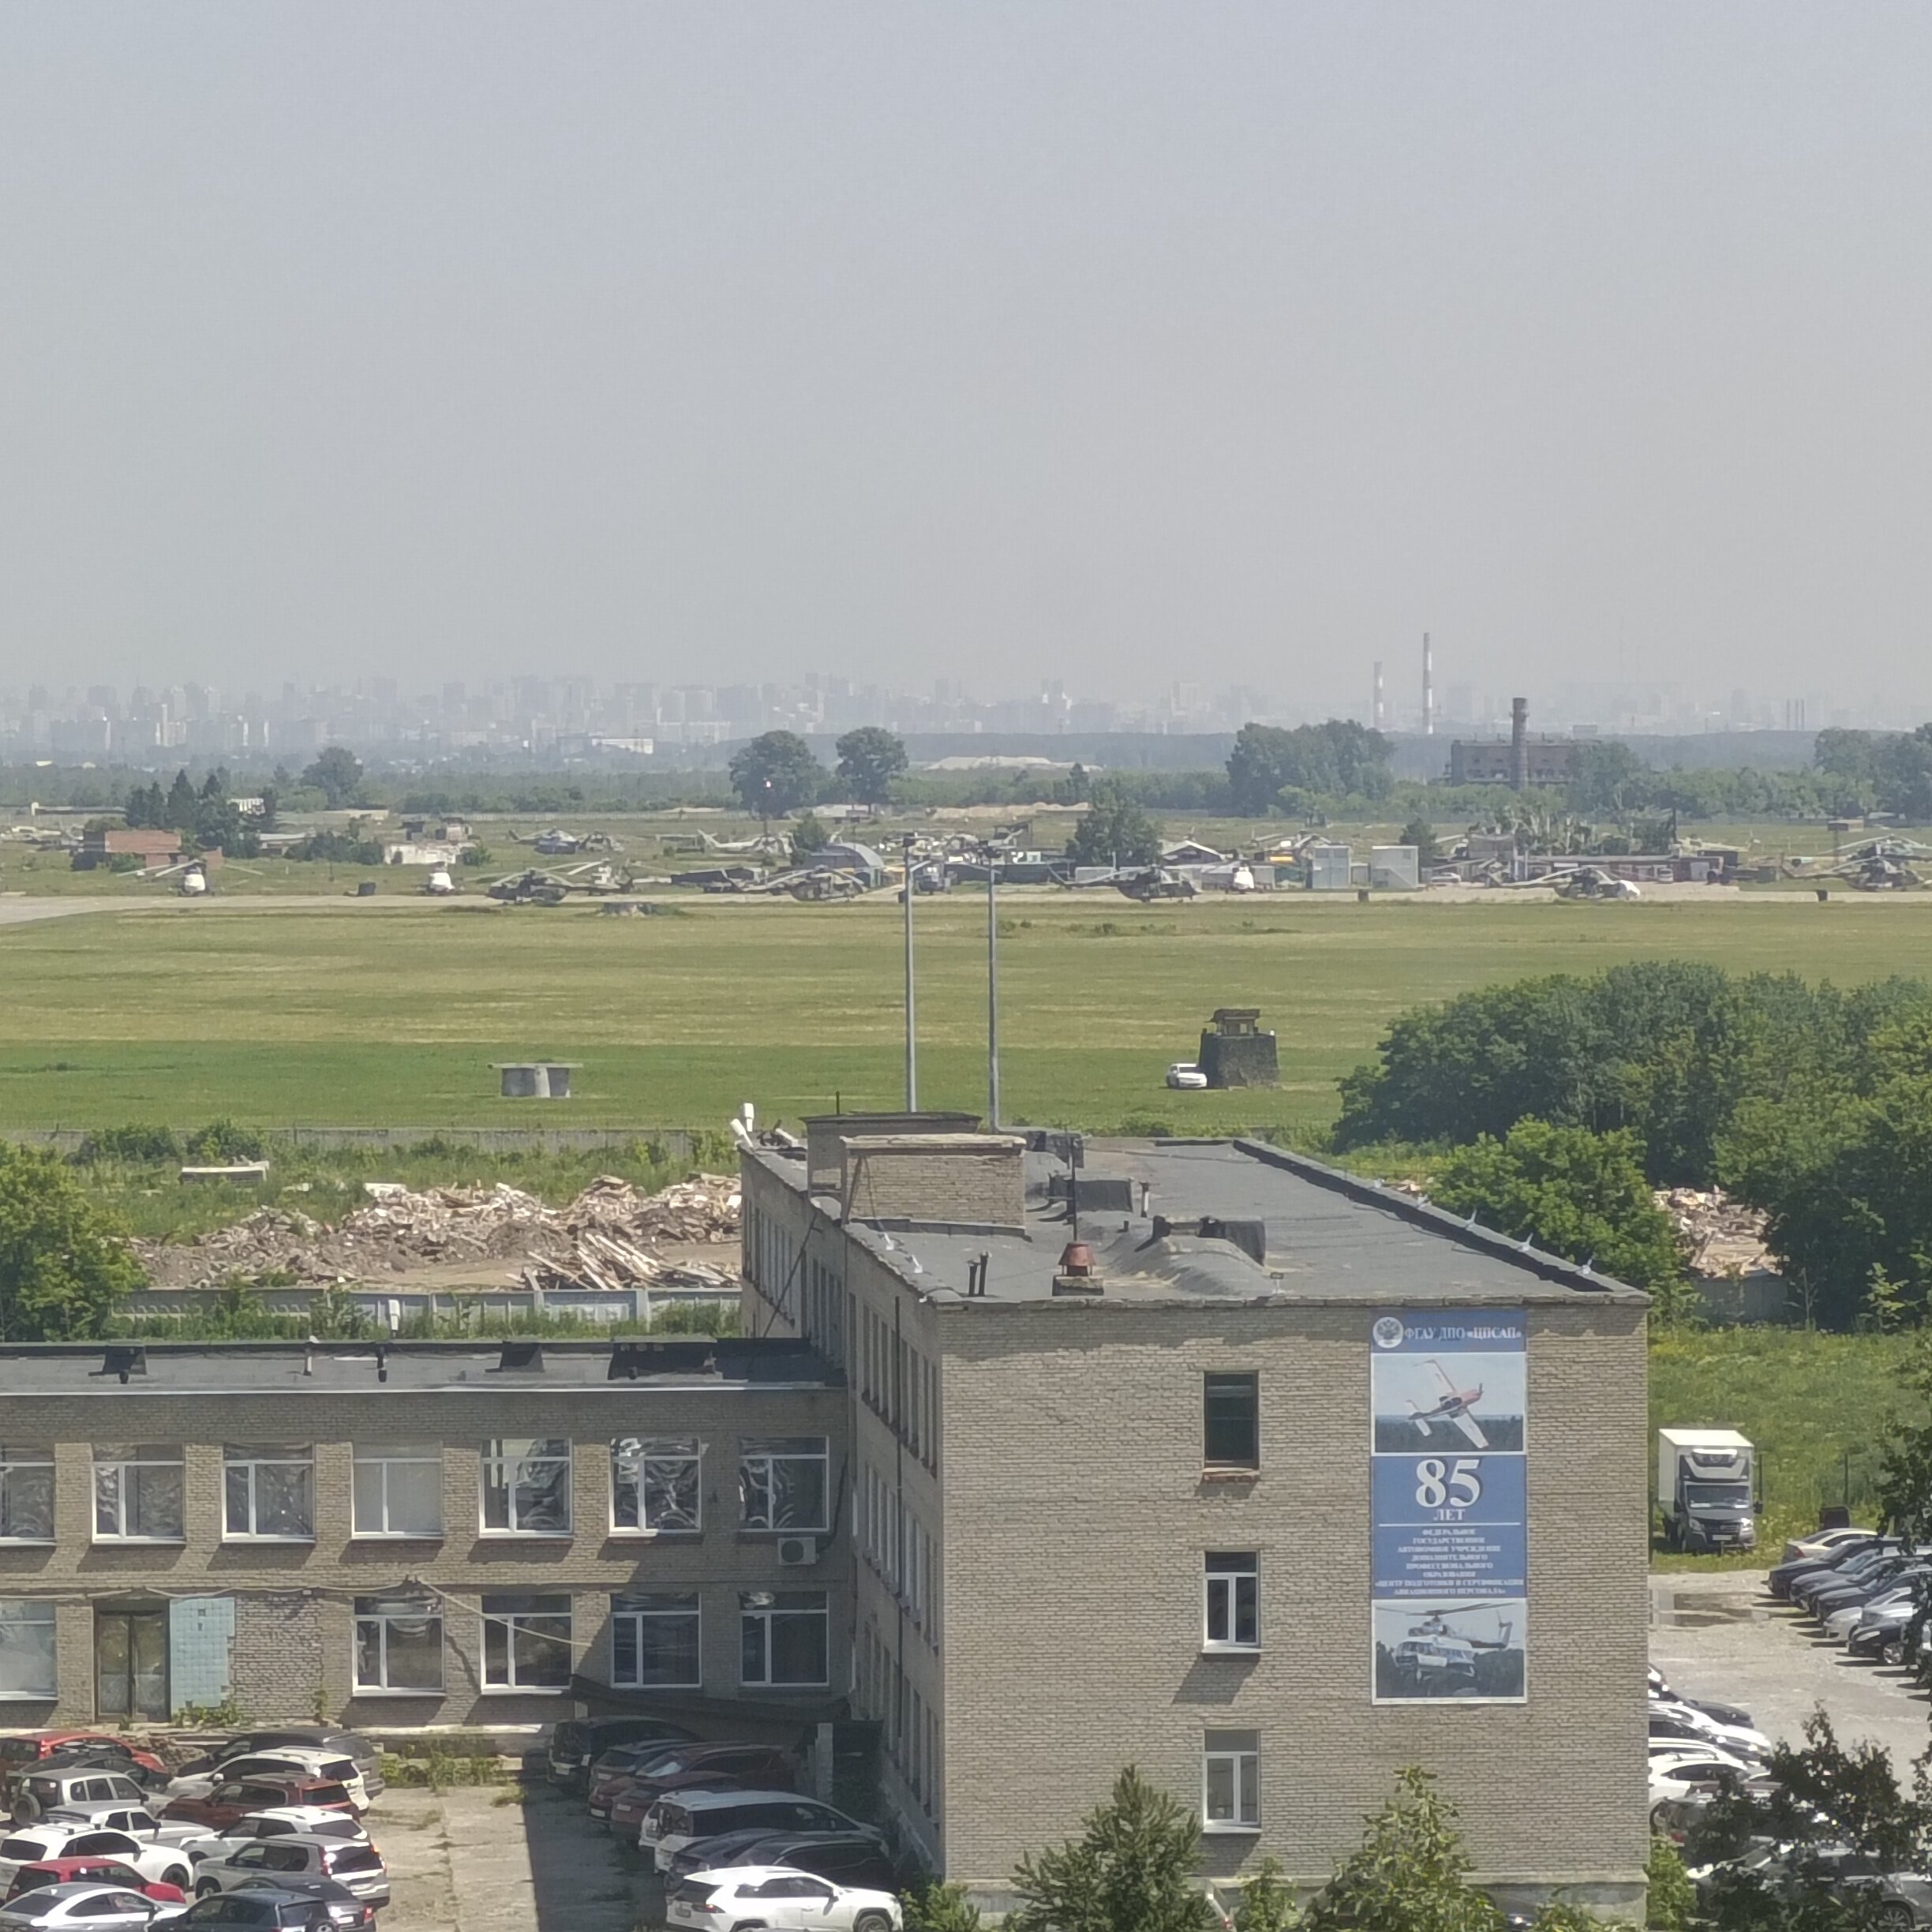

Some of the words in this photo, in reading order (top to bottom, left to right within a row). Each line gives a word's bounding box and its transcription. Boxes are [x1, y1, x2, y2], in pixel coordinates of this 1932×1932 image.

[1404, 1327, 1436, 1340] ФГАУ
[1438, 1327, 1466, 1341] ДПО
[1415, 1458, 1481, 1507] 85
[1433, 1508, 1466, 1521] ЛЕТ
